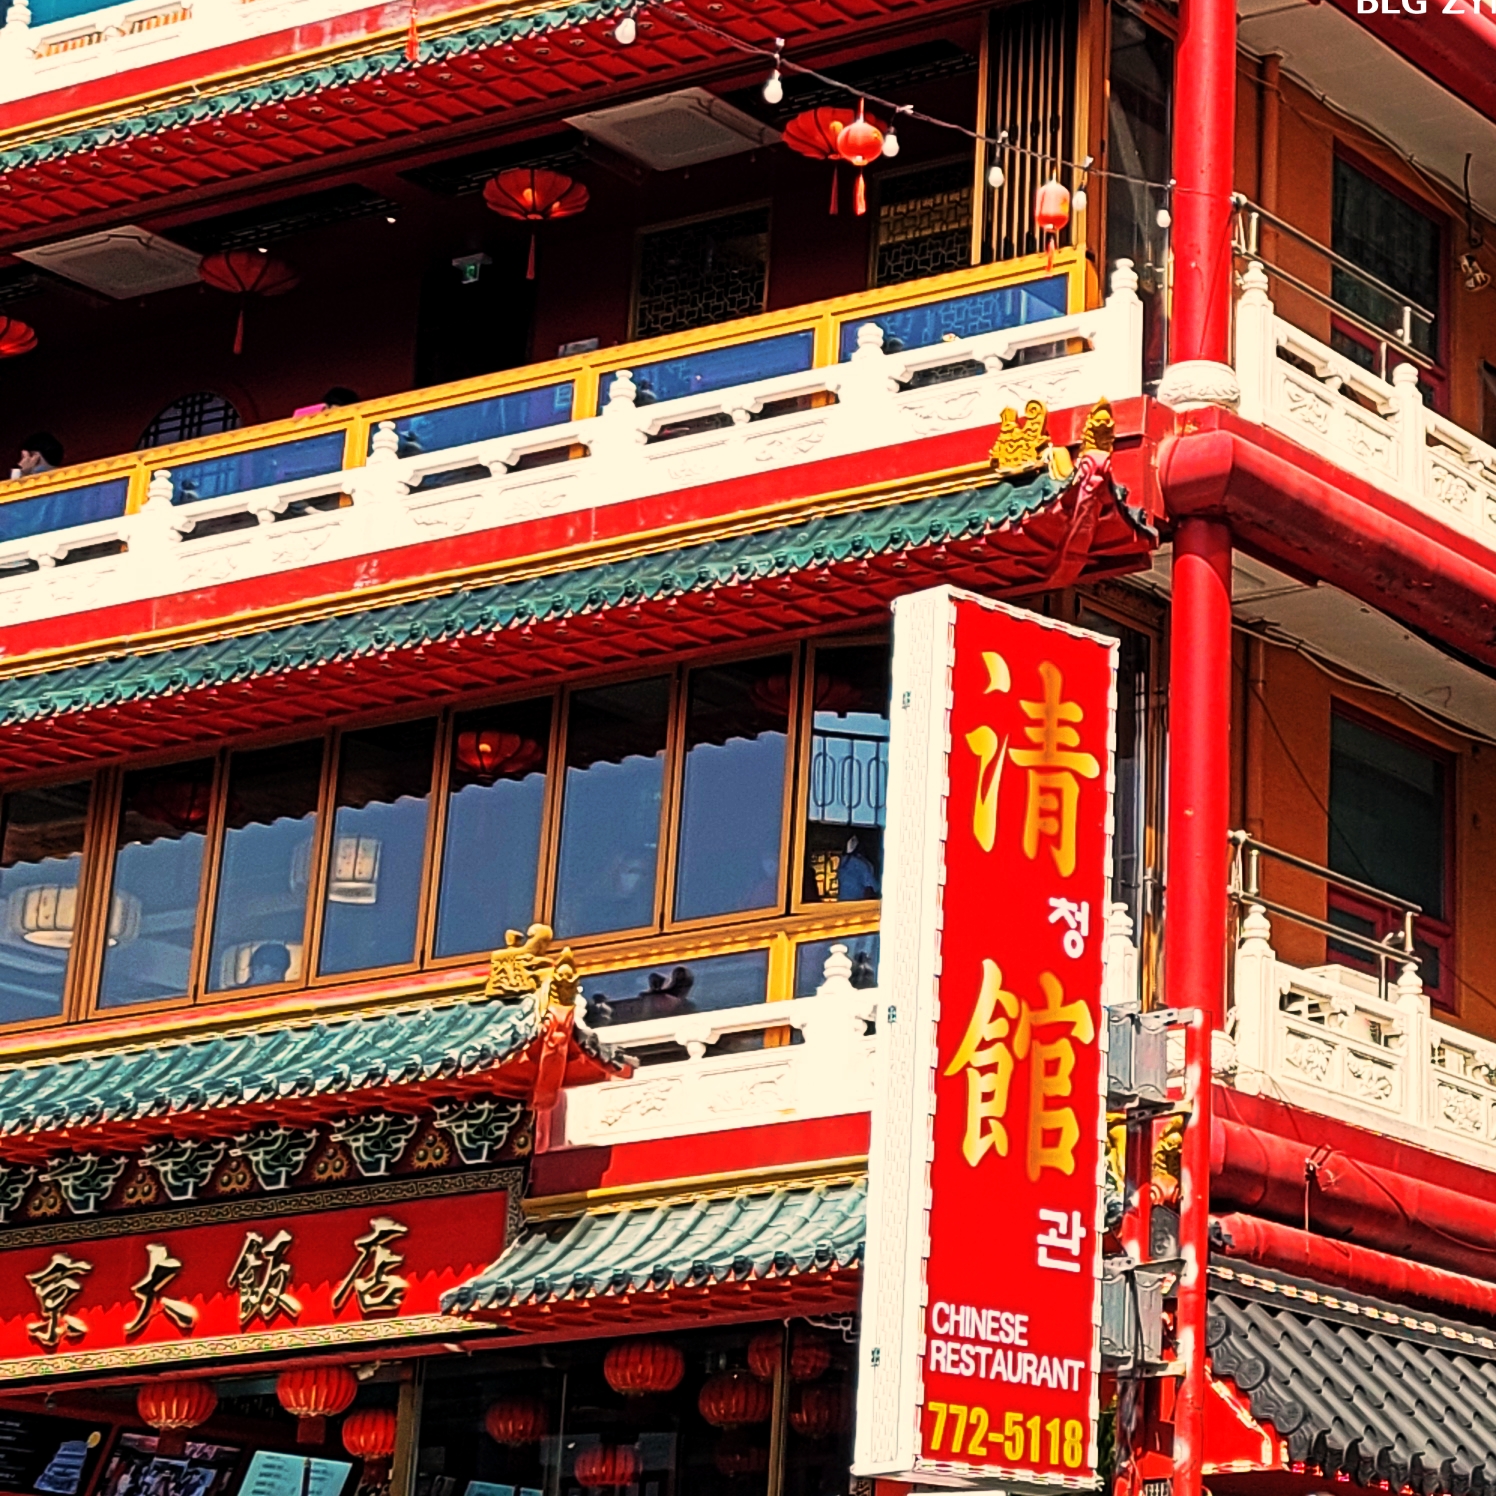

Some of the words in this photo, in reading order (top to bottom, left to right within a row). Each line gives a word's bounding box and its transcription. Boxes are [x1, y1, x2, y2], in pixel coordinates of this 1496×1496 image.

[24, 1216, 409, 1347] 京大飯店
[931, 1302, 1029, 1346] CHINESE
[929, 1339, 1085, 1392] RESTAURANT
[928, 1401, 1083, 1468] 772-5118
